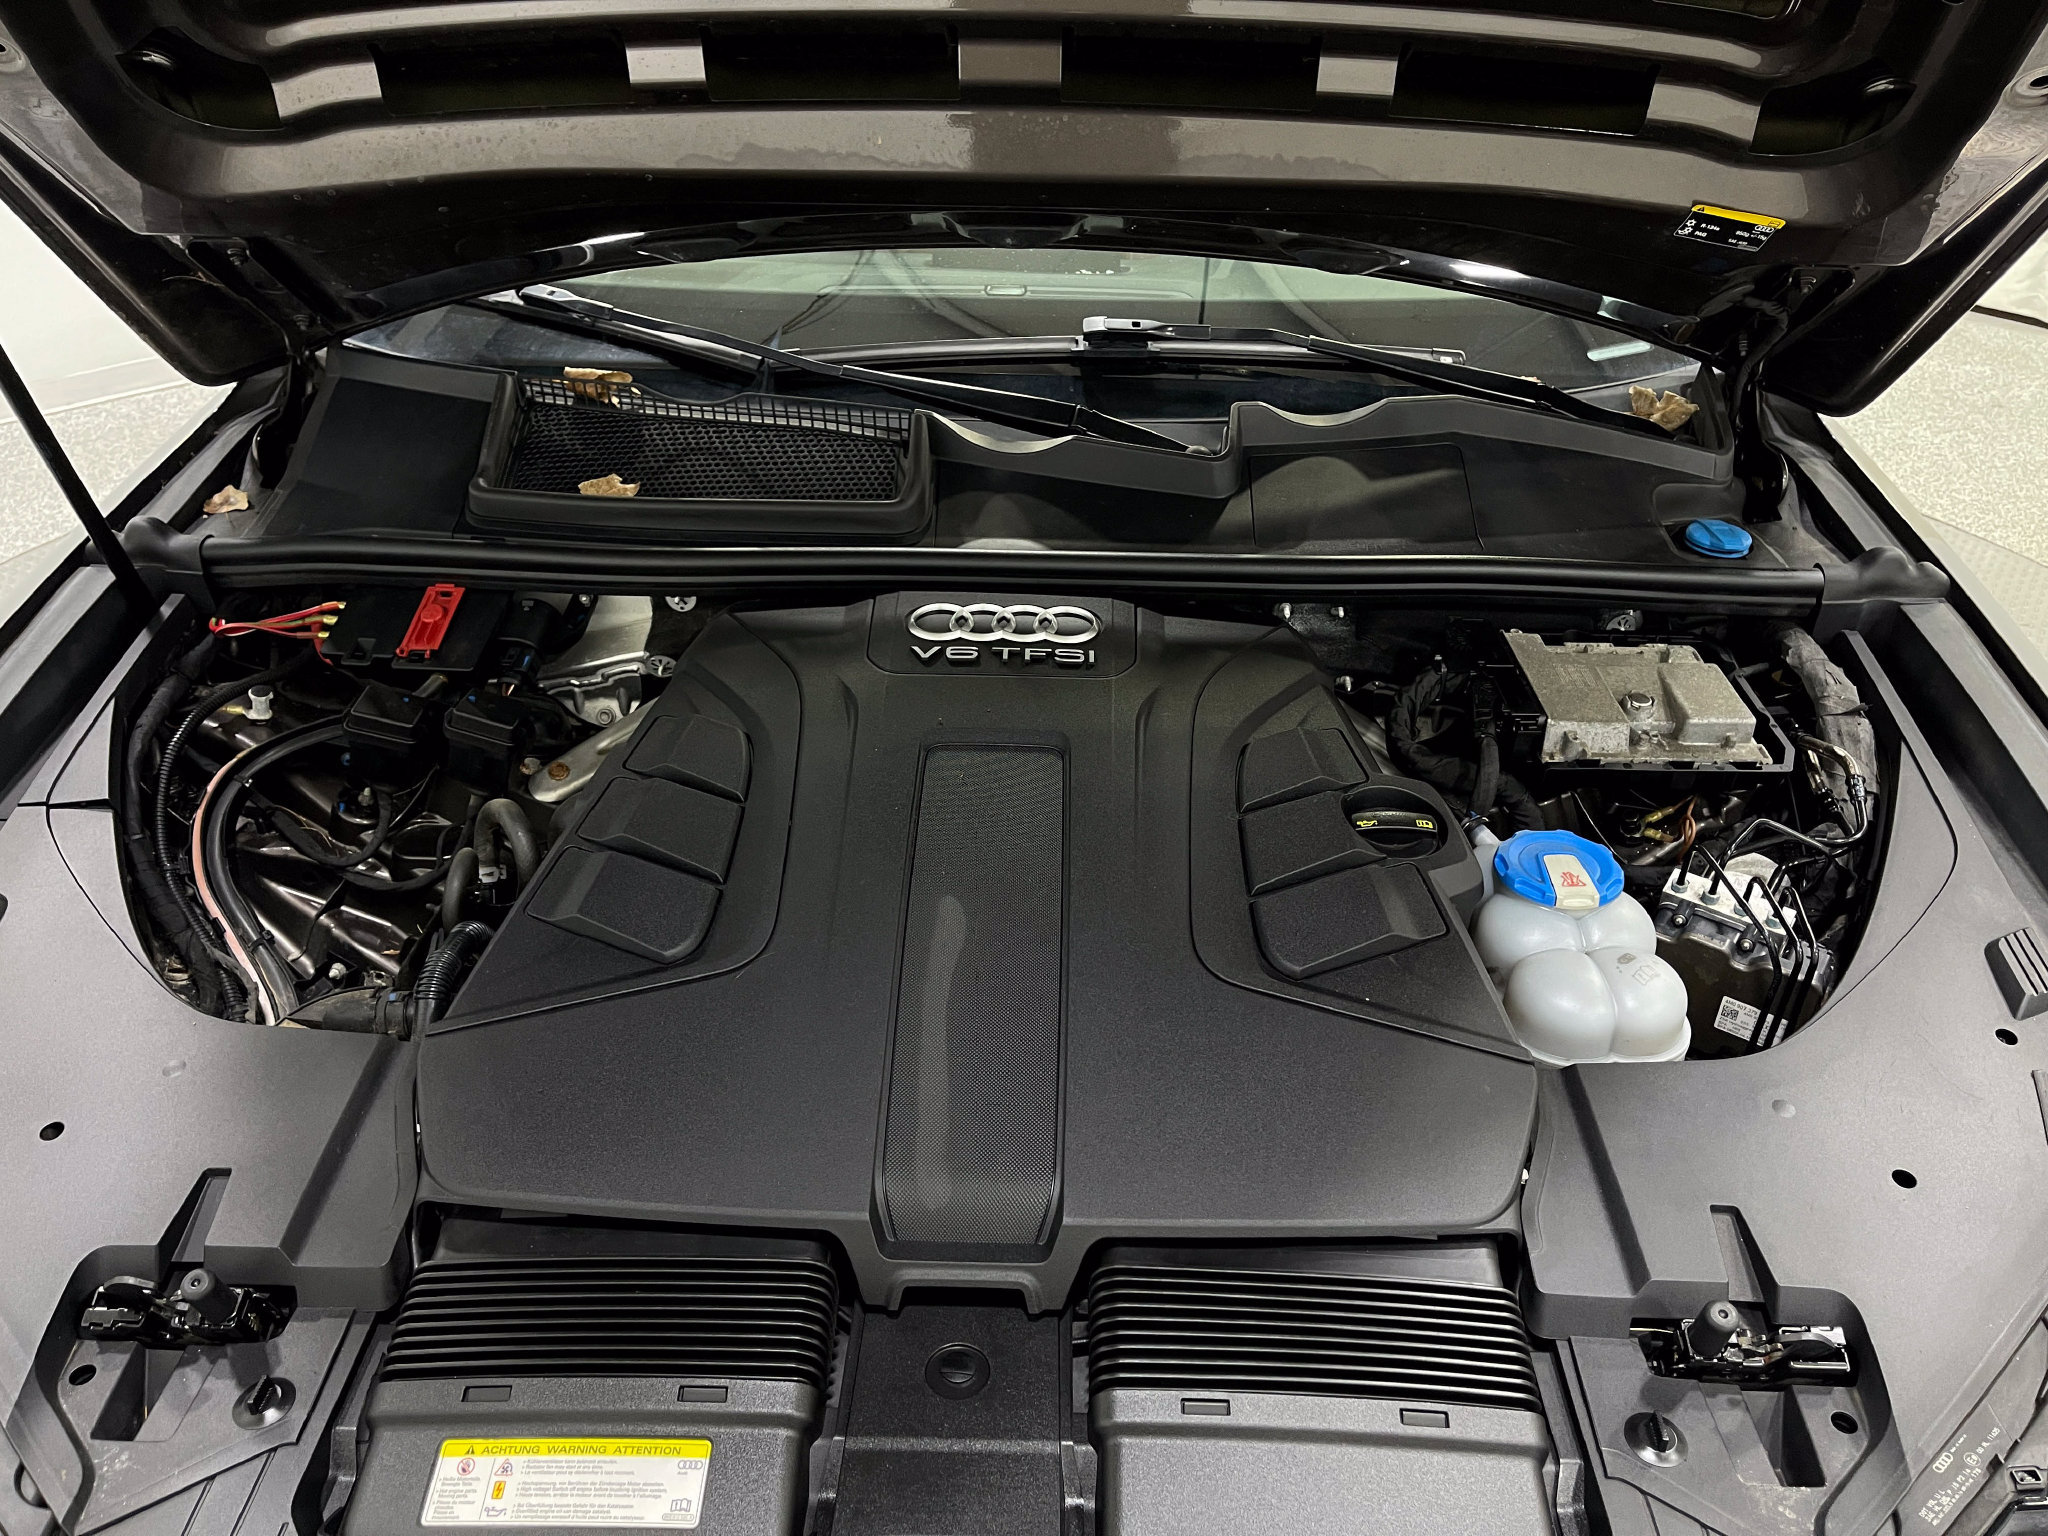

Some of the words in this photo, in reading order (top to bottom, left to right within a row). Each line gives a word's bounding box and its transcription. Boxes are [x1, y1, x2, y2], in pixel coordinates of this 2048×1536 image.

[1700, 223, 1720, 231] R-134a
[910, 646, 979, 660] V6
[991, 647, 1095, 663] TFSI
[481, 1445, 540, 1455] ACHTUNG
[546, 1445, 607, 1455] WARNING
[612, 1446, 682, 1456] ATTENTION
